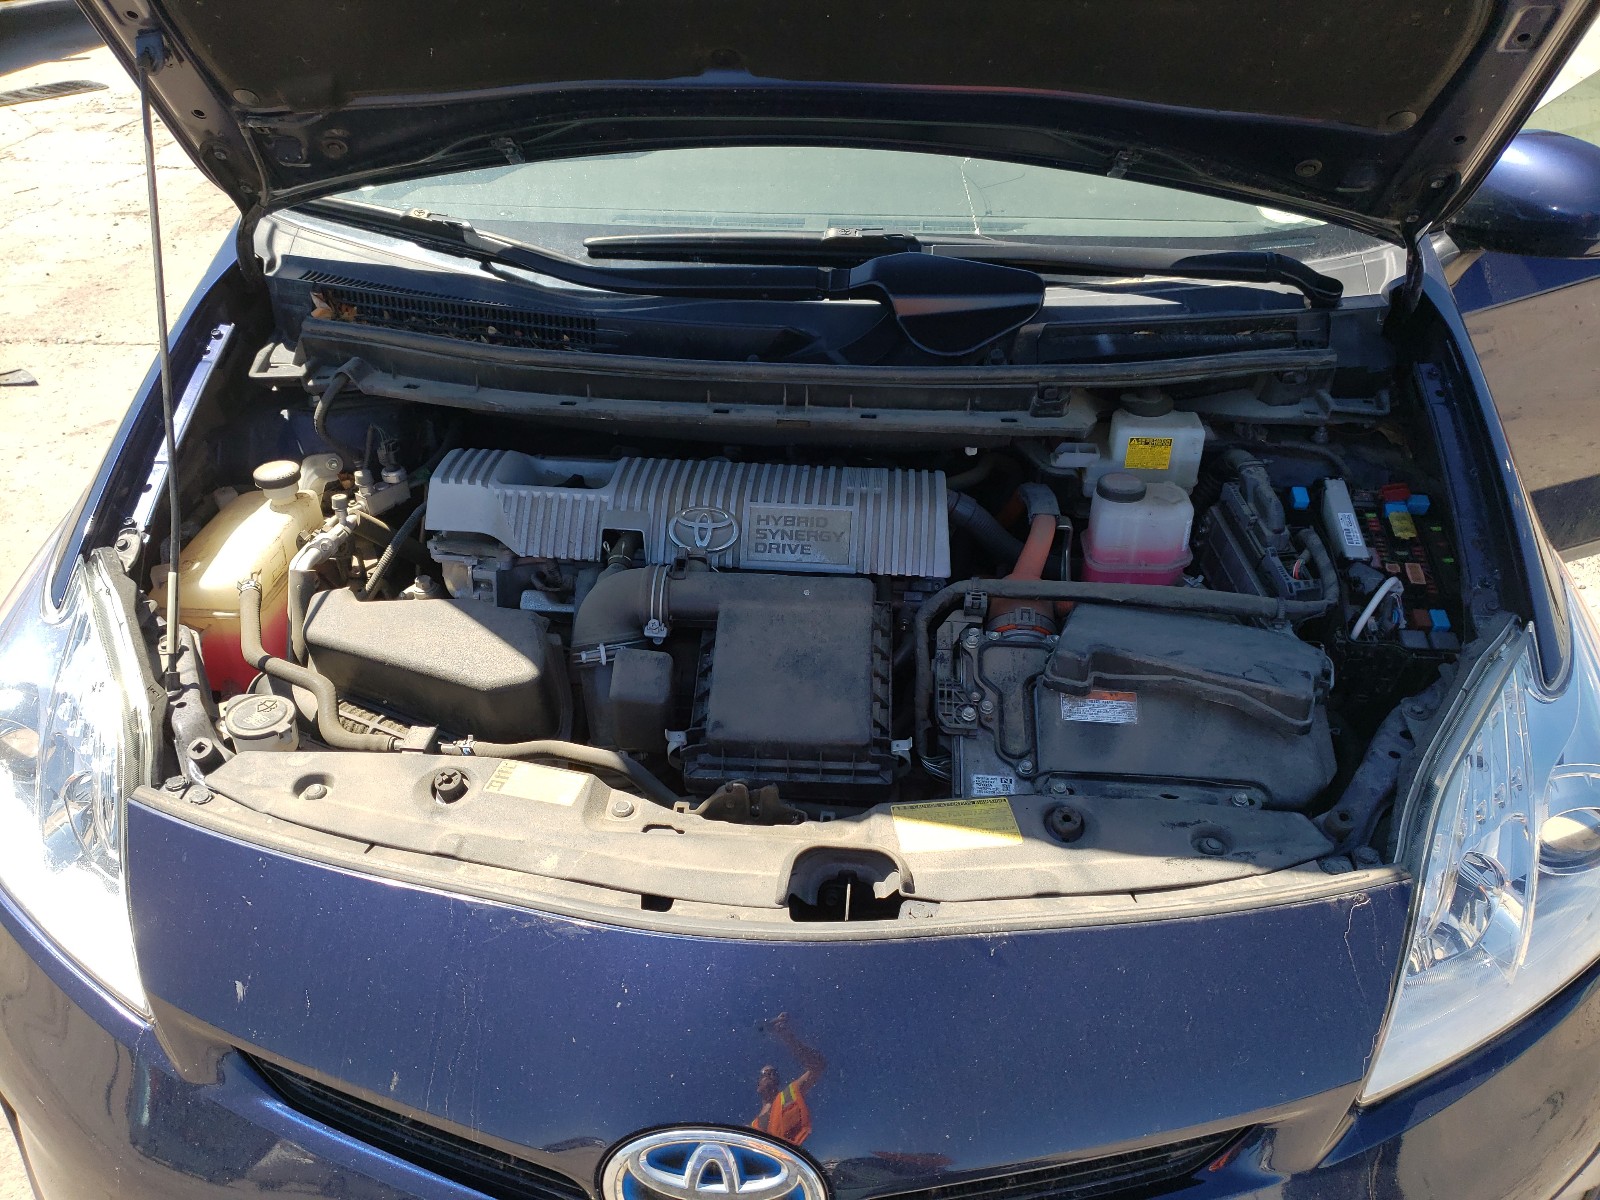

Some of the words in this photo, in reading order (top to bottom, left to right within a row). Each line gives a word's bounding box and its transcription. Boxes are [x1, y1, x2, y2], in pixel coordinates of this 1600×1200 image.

[756, 514, 829, 528] HYBRID
[755, 528, 846, 542] SYNERGY
[754, 542, 812, 555] DRIVE
